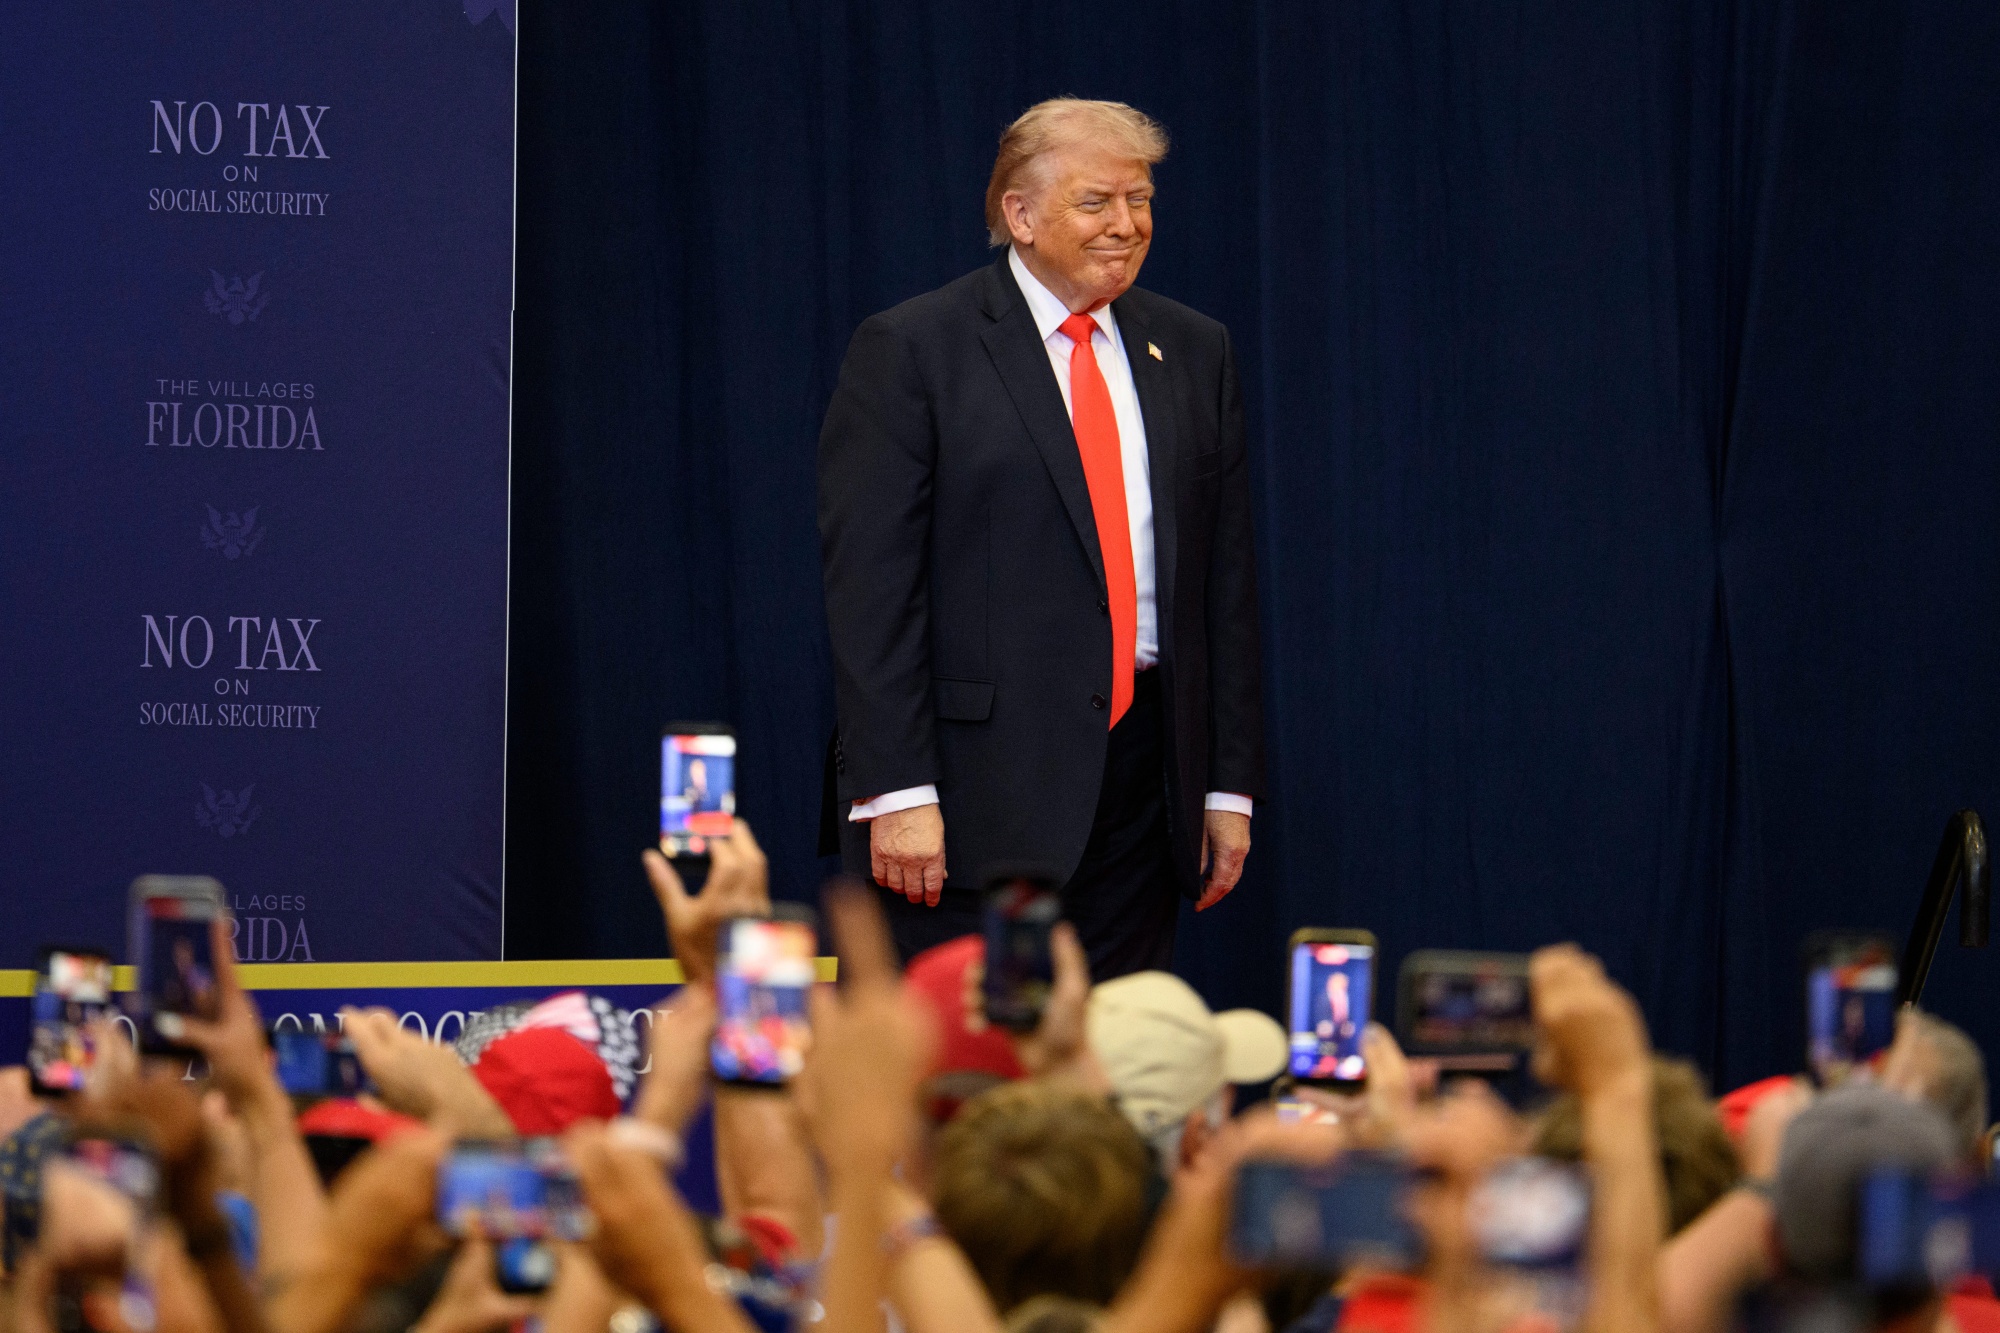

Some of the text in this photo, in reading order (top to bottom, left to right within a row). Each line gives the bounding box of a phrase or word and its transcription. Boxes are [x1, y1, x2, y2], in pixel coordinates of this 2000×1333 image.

[150, 100, 330, 159] NO TAX
[223, 165, 257, 182] ON
[149, 188, 329, 216] SOCIAL SECURITY
[156, 379, 315, 399] THE VILLAGES
[145, 402, 324, 450] FLORIDA
[140, 615, 321, 672] NO TAX
[214, 678, 249, 695] ON
[140, 702, 321, 728] SOCIAL SECURITY
[224, 917, 315, 962] RIDA
